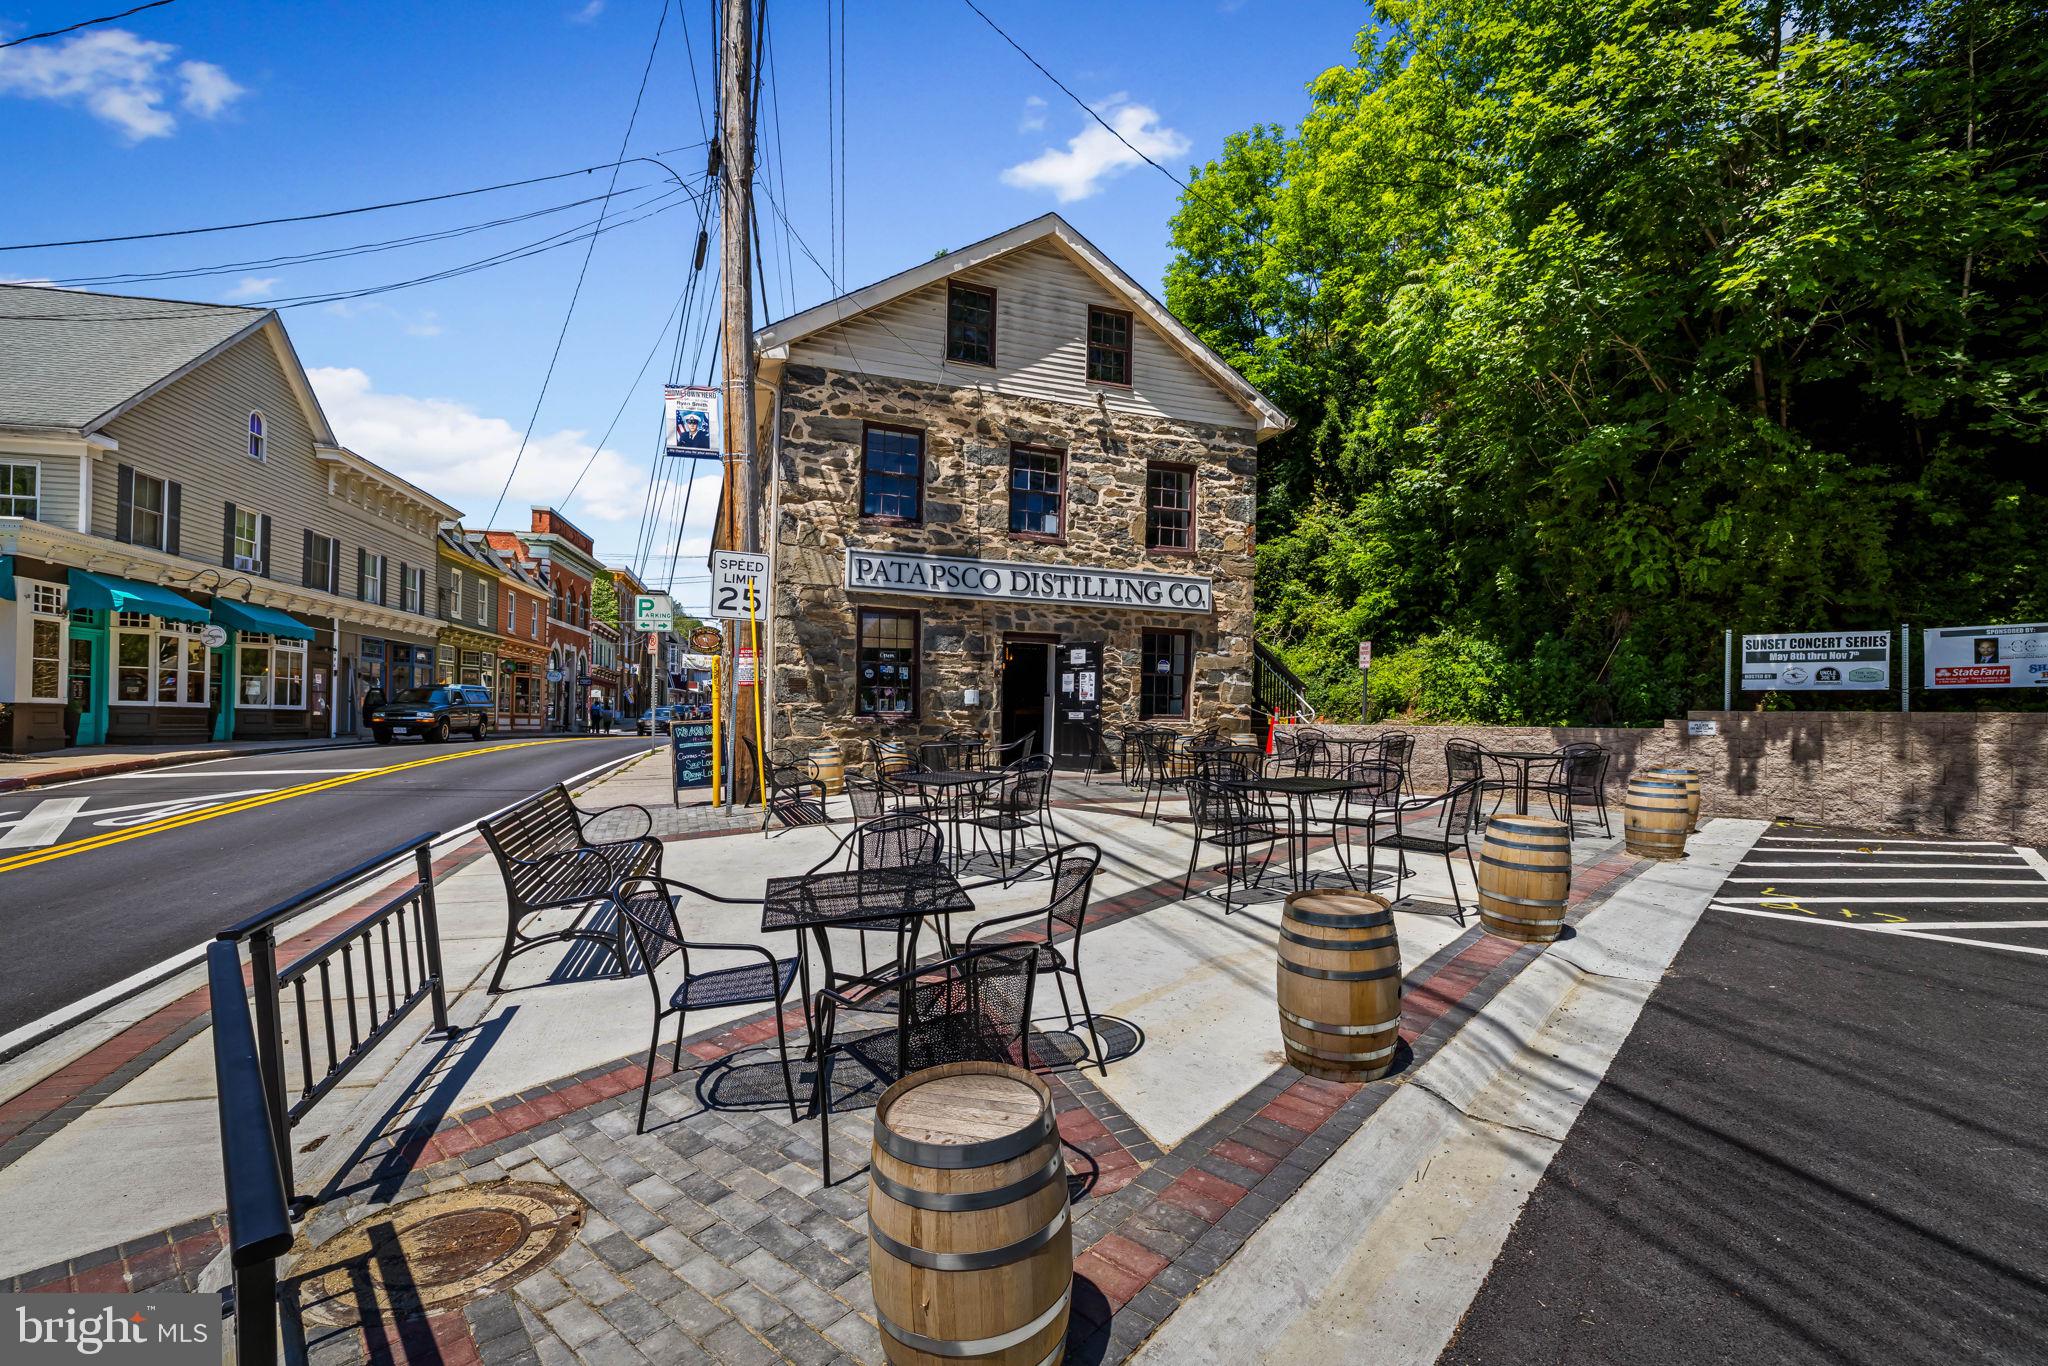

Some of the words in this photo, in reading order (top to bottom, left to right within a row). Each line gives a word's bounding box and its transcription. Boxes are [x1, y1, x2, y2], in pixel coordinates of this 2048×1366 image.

[720, 559, 764, 572] SPEED
[724, 573, 758, 585] LIMIT
[855, 557, 1001, 591] PATAPSCO
[1010, 570, 1162, 603] DISTILLING
[1168, 582, 1206, 608] CO.
[718, 587, 761, 612] 25
[639, 599, 671, 618] PARKING
[1745, 638, 1787, 651] SUNSET
[1789, 636, 1843, 650] CONCERT
[1845, 635, 1887, 648] SERIES
[1769, 653, 1789, 662] May
[1790, 652, 1806, 660] 8th
[1807, 652, 1828, 660] thru
[1829, 651, 1847, 660] Nov
[1849, 651, 1860, 659] 7th
[462, 1243, 544, 1287] SEWER
